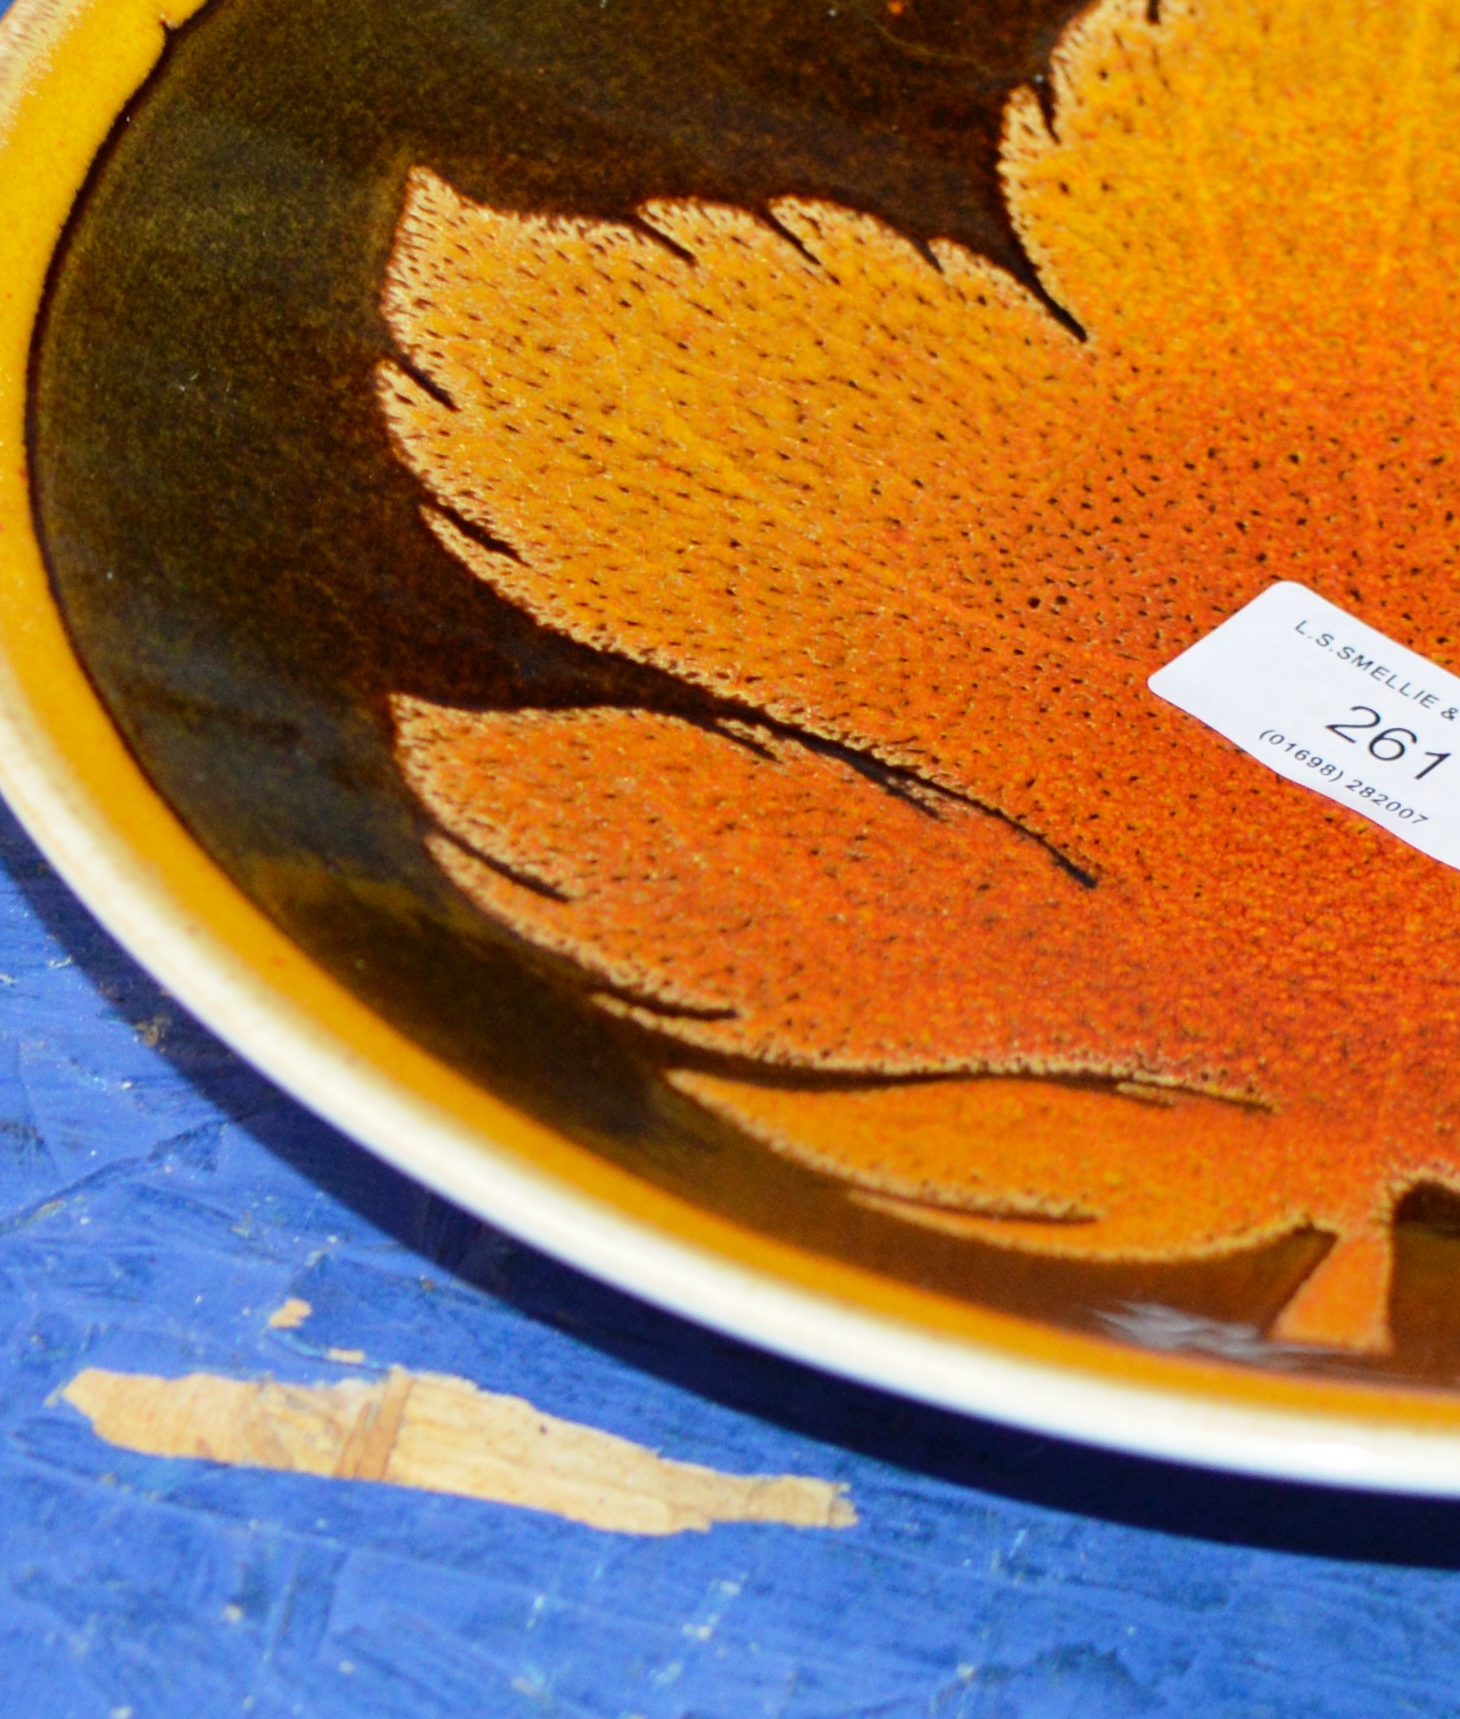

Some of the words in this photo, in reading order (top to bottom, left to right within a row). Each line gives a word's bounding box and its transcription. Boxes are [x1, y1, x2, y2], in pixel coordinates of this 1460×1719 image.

[1325, 705, 1452, 781] 261
[1440, 706, 1459, 722] &
[1258, 729, 1345, 783] (01698)
[1344, 779, 1430, 825] 282007
